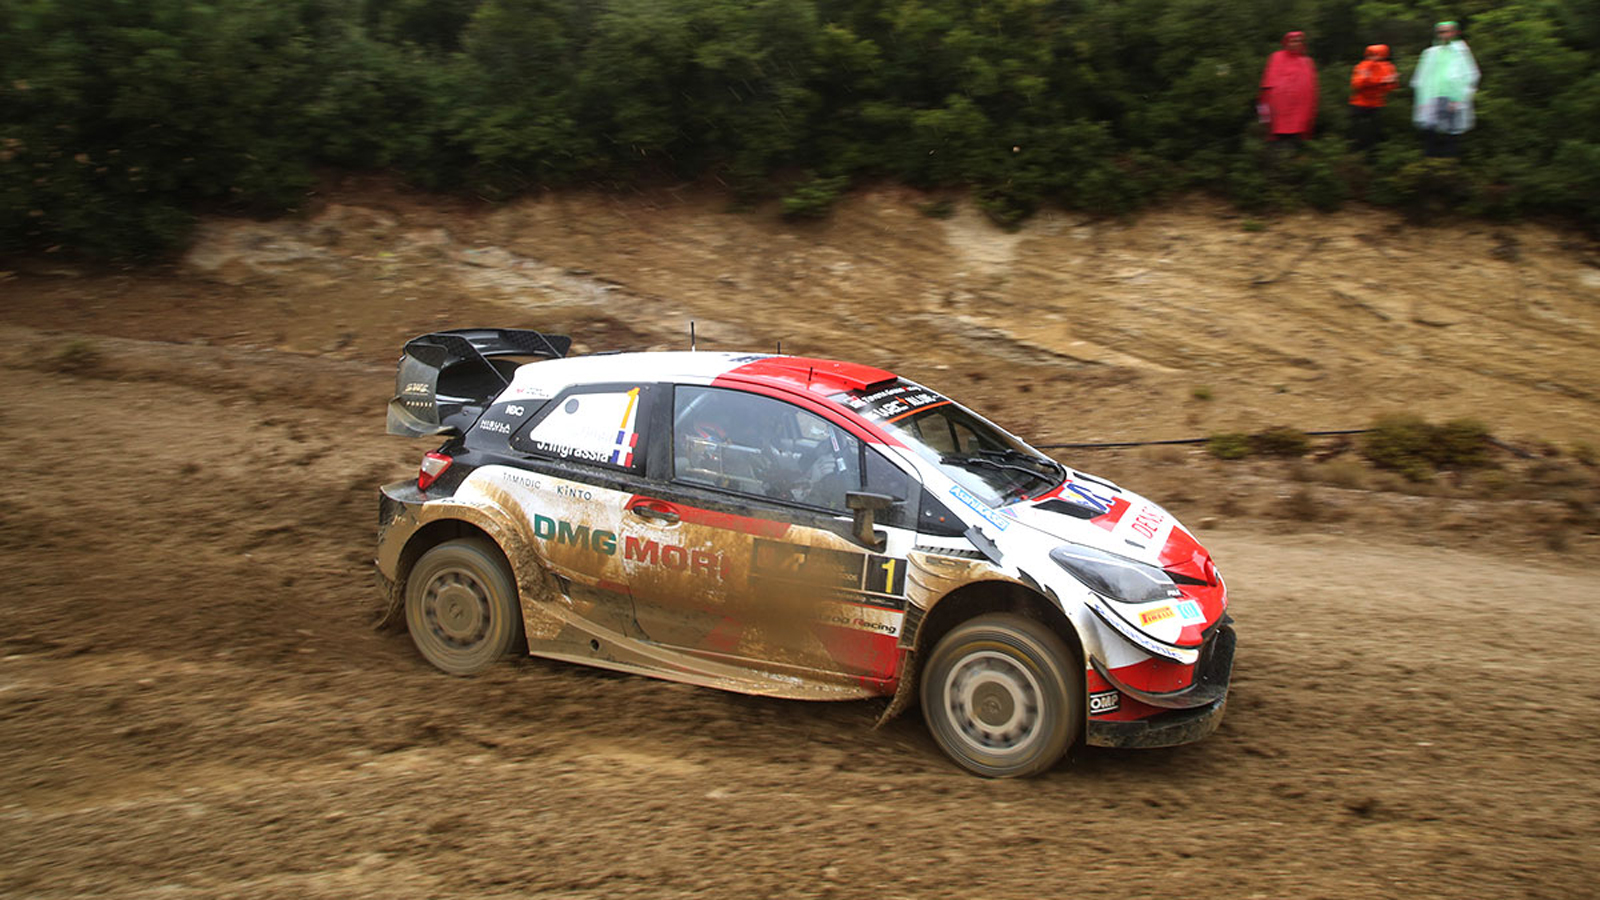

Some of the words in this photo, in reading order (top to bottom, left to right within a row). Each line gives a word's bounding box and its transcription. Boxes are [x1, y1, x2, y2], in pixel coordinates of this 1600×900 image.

[620, 386, 640, 429] 1
[536, 441, 609, 463] J.Ingrassia
[503, 472, 542, 490] TAMADIC
[534, 514, 617, 556] DMG
[881, 559, 896, 594] 1
[1140, 607, 1174, 624] PIRELLI
[1090, 694, 1119, 709] OMP
